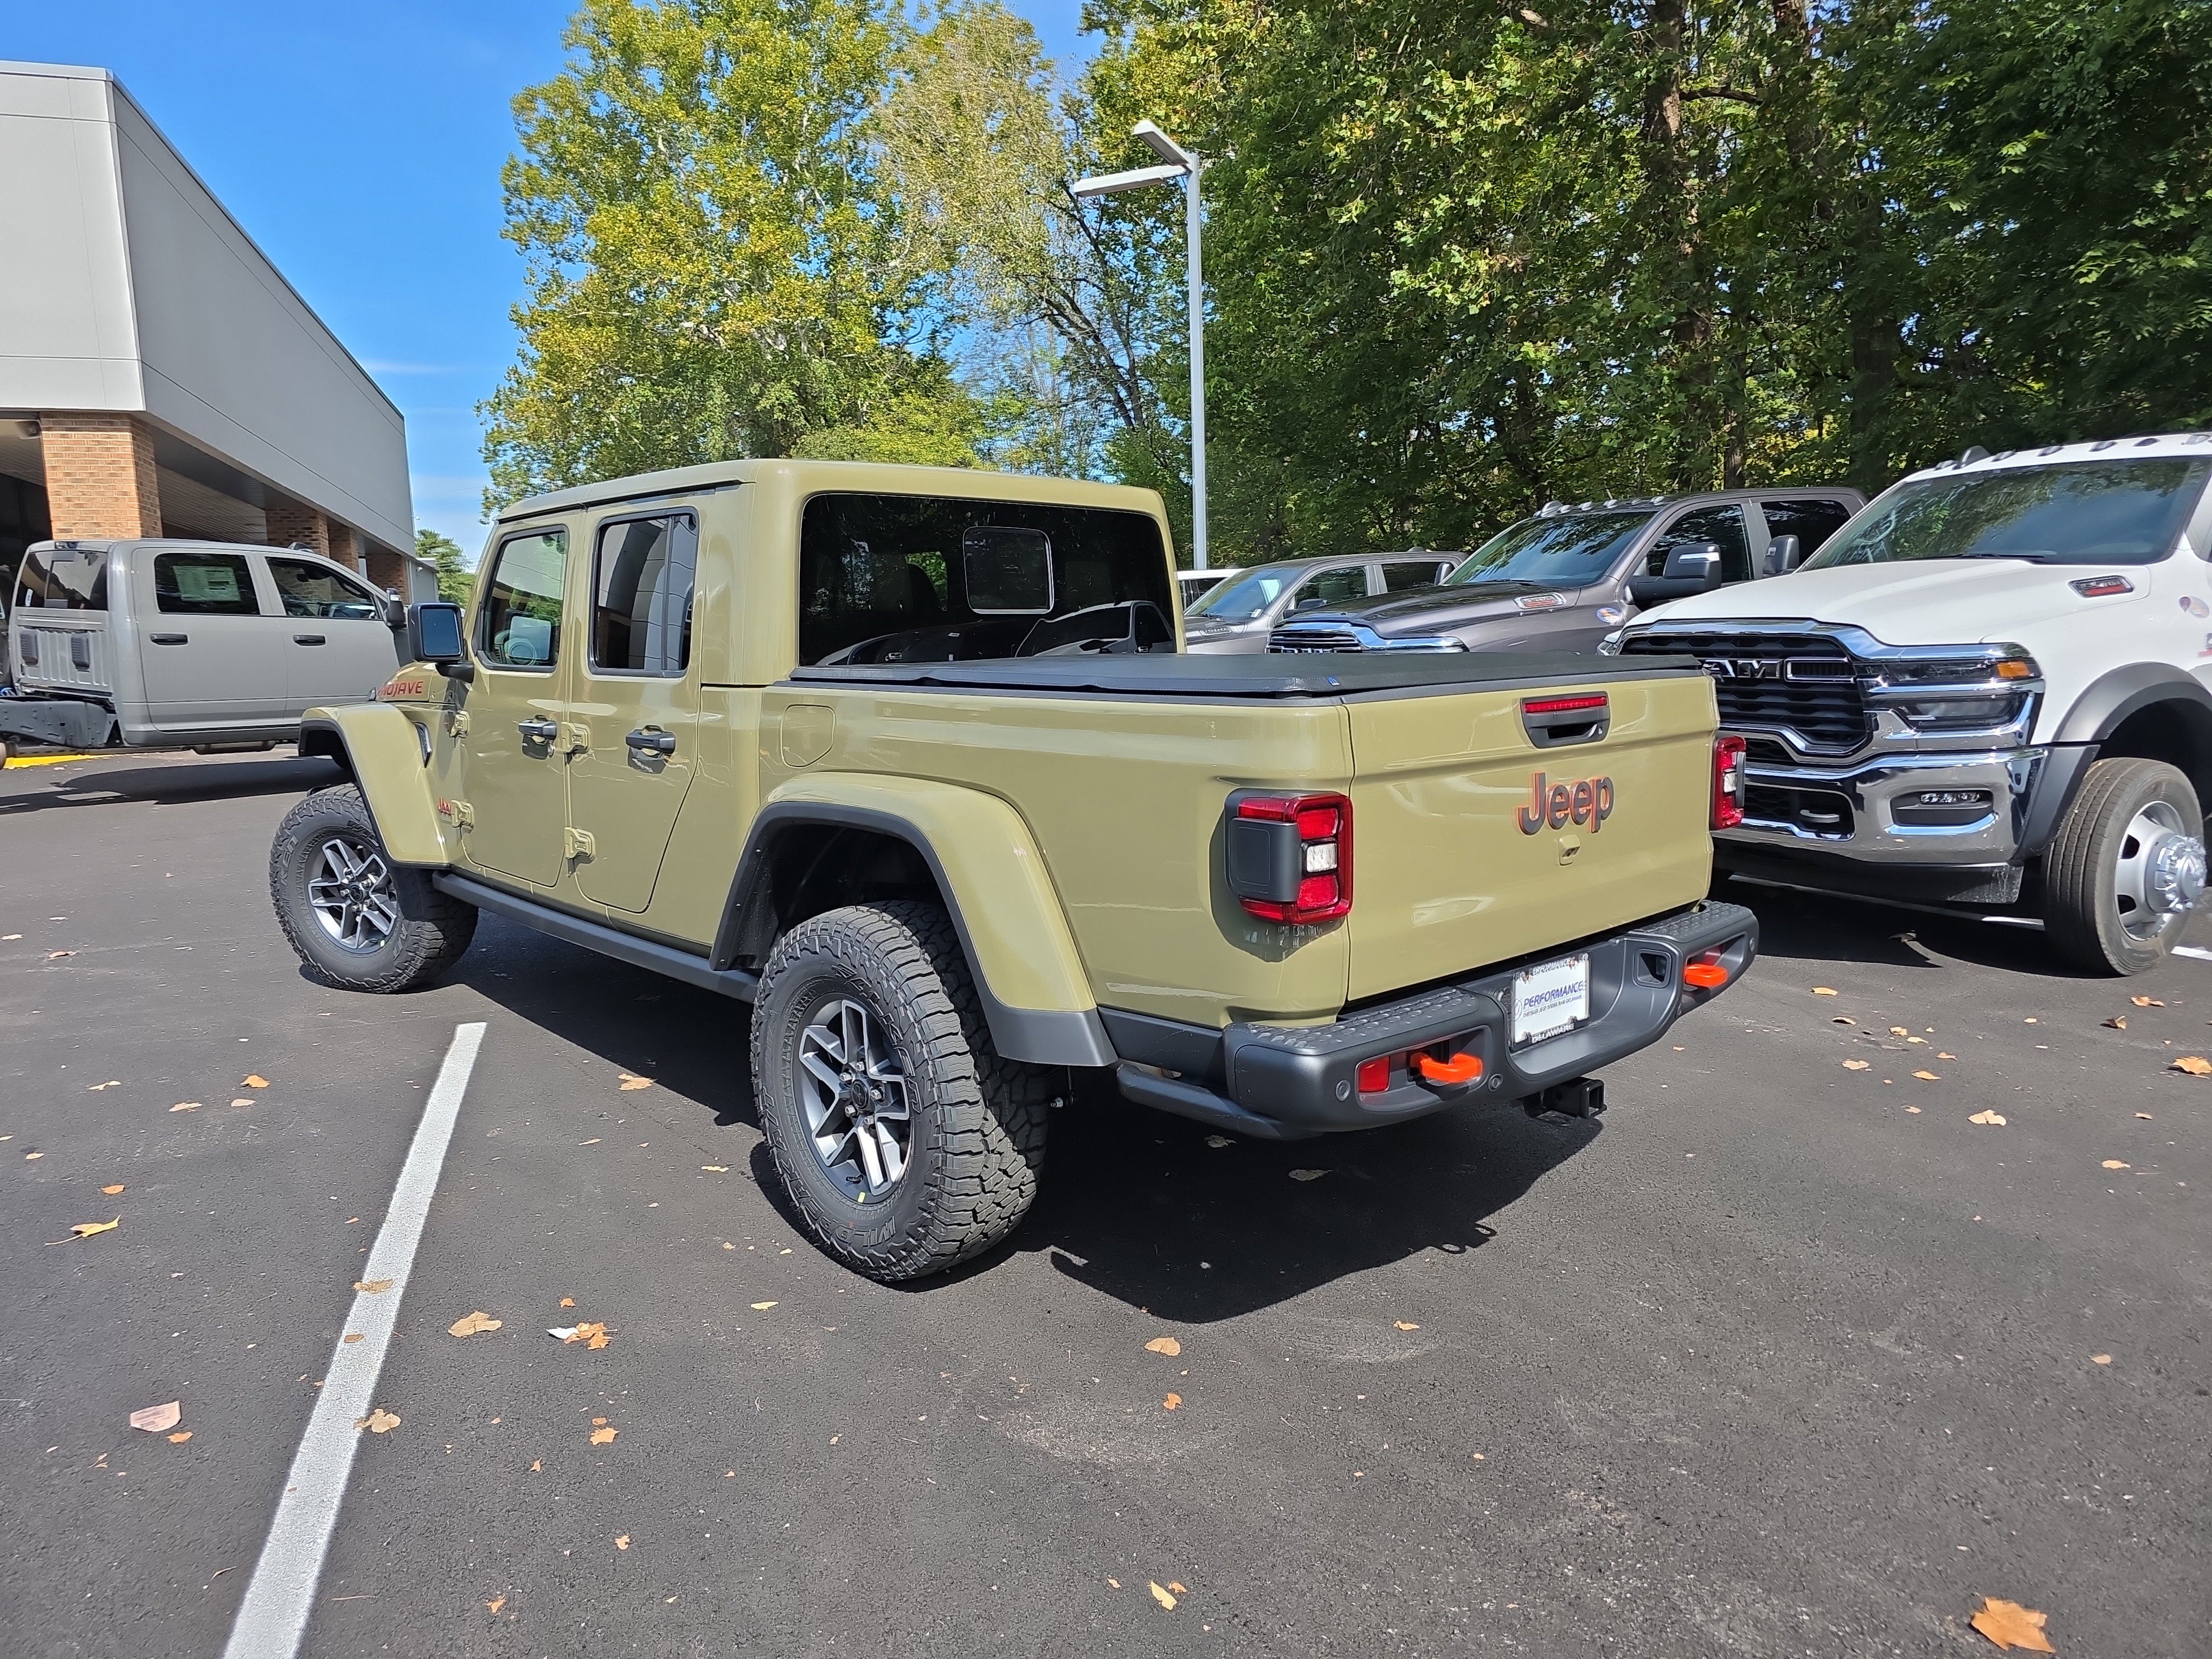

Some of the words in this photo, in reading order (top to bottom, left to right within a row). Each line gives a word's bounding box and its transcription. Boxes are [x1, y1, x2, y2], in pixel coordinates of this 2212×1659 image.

[1702, 659, 1782, 681] AM
[378, 680, 424, 698] MOJAVE
[1517, 771, 1615, 835] Jeep
[1523, 981, 1583, 1009] PERFORMANCE
[832, 963, 922, 1114] FALKEN
[1532, 1023, 1574, 1044] DELAWARE
[779, 1158, 897, 1248] WILDPEAK
